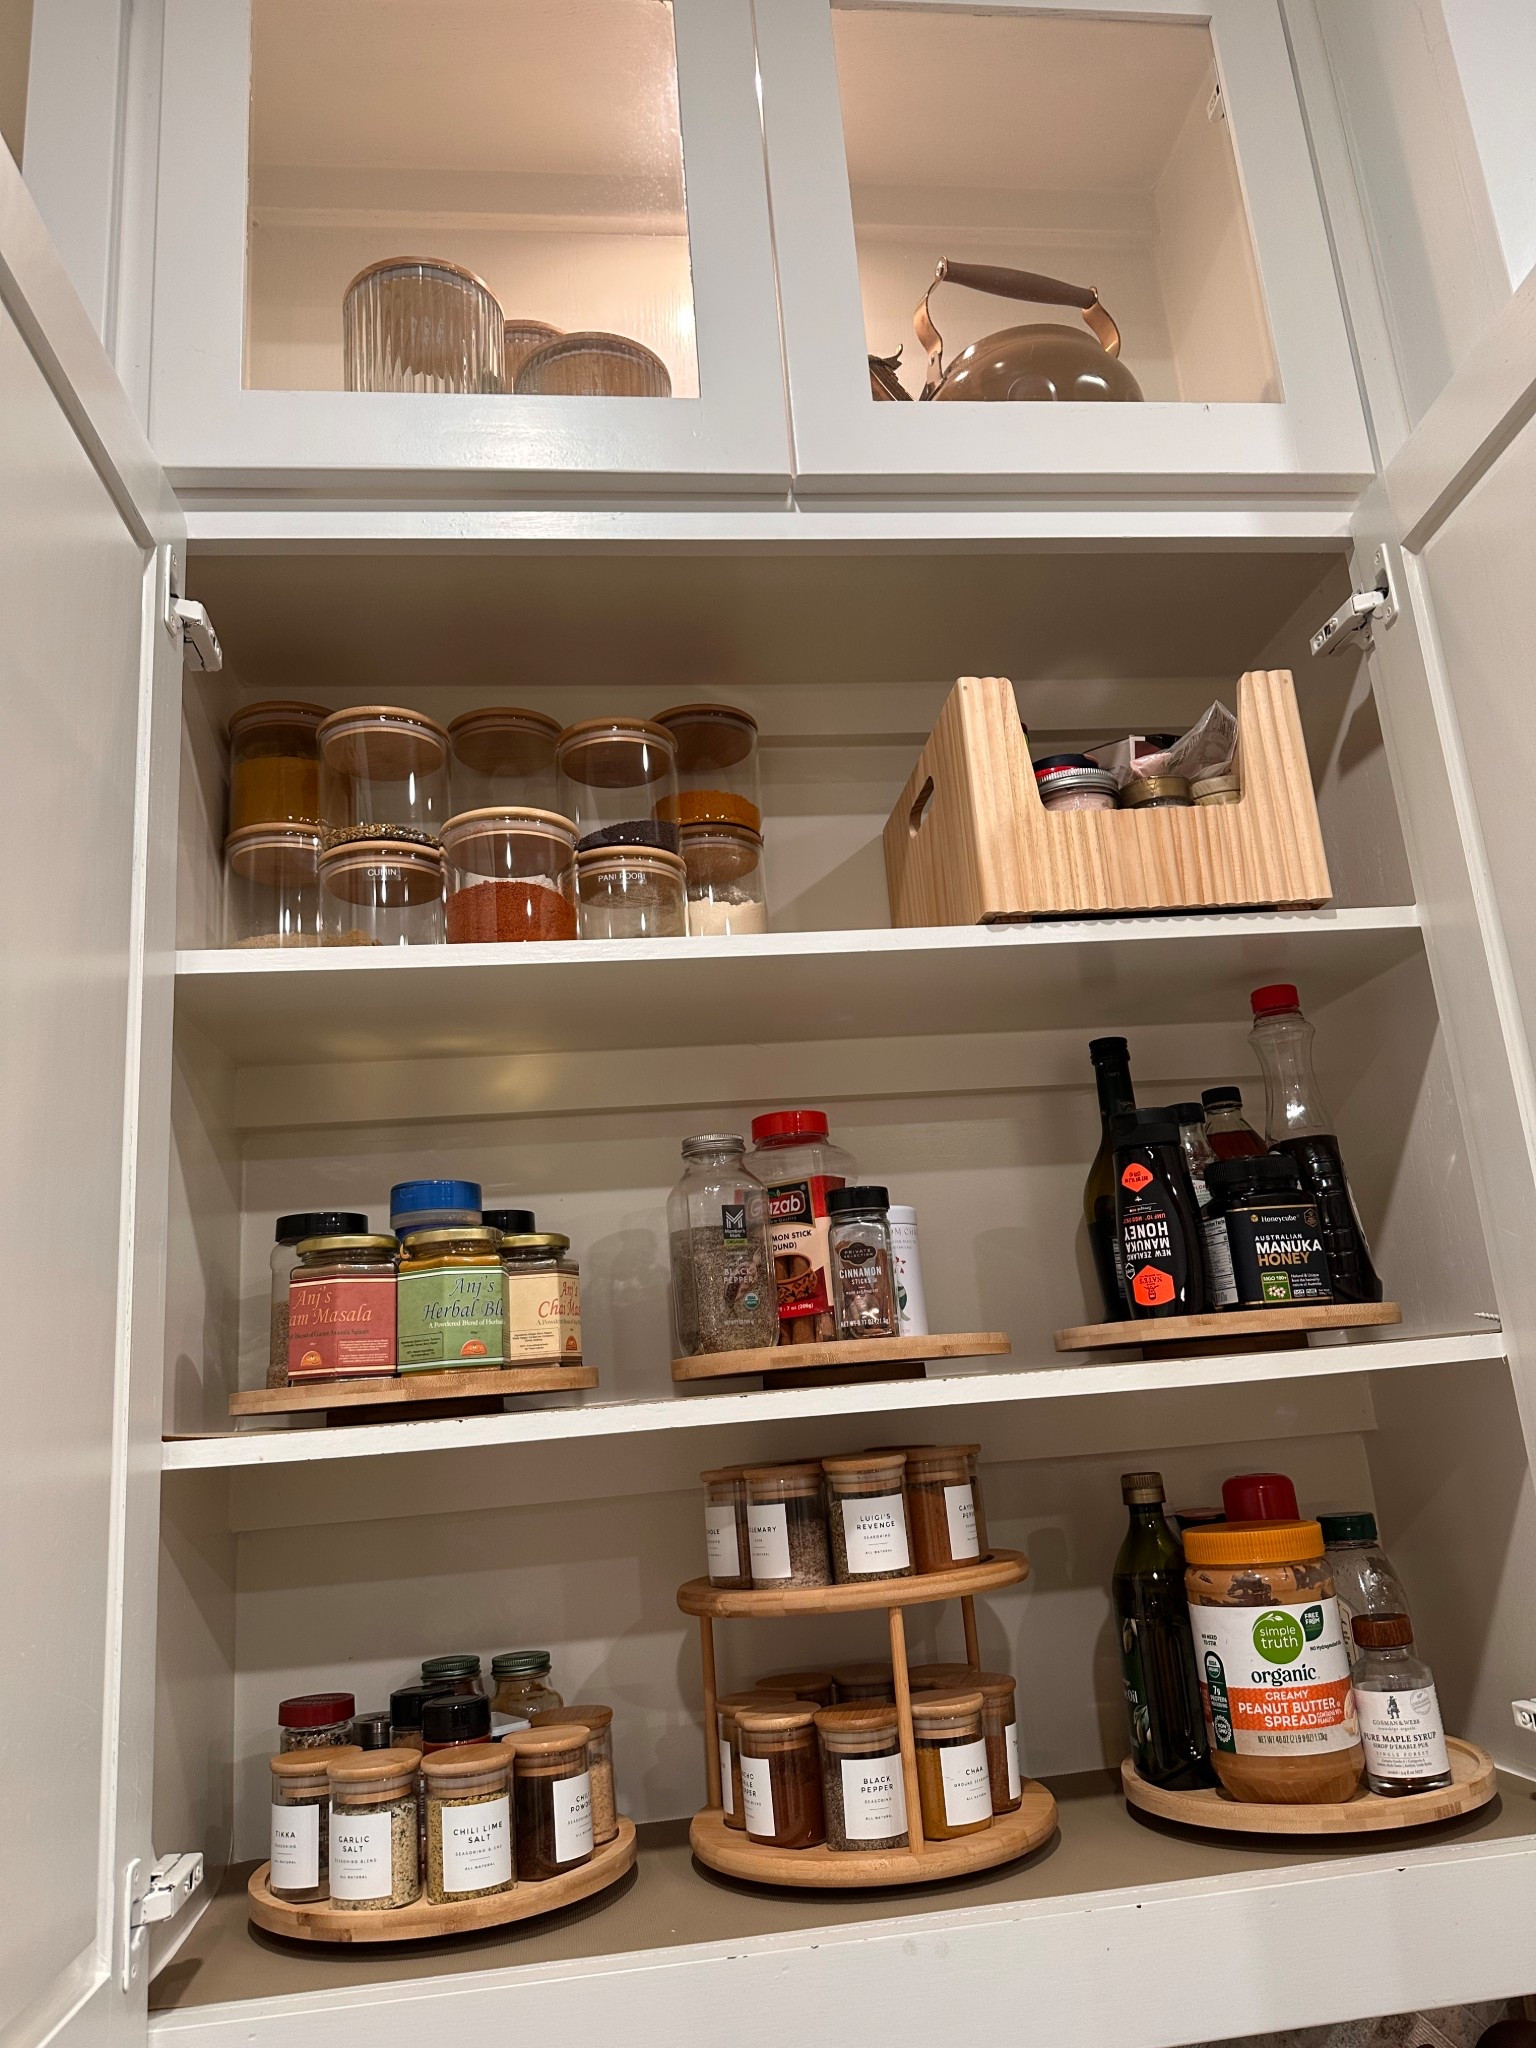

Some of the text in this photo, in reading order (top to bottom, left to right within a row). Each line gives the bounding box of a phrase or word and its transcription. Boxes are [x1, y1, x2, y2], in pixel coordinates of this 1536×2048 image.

[598, 873, 617, 882] PANI
[1261, 1214, 1297, 1223] Honeycube
[791, 1229, 812, 1239] STICK
[1124, 1221, 1169, 1241] HONEY
[1254, 1233, 1303, 1242] AUSTRALIAN
[1125, 1236, 1171, 1253] MANUKA
[1255, 1238, 1323, 1255] MANUKA
[1126, 1248, 1172, 1261] NEW ZEALAND
[1257, 1251, 1310, 1267] HONEY
[724, 1268, 753, 1276] BLACK
[839, 1265, 882, 1279] CINNAMON
[723, 1276, 754, 1284] PEPPER
[1139, 1276, 1163, 1285] NATE'S
[448, 1275, 495, 1299] Anj's
[560, 1281, 578, 1302] Anj's
[292, 1286, 332, 1311] Anj's
[422, 1299, 480, 1321] Herbal
[538, 1298, 566, 1318] Chai
[312, 1303, 372, 1325] Masala
[434, 1320, 461, 1328] Powdered
[461, 1319, 479, 1327] Blend
[860, 1513, 891, 1522] LUIGI'S
[856, 1520, 896, 1530] REVENGE
[1305, 1617, 1321, 1625] FROM
[1260, 1625, 1296, 1638] simple
[1261, 1635, 1298, 1649] truth
[1251, 1663, 1317, 1687] organic
[1212, 1685, 1221, 1696] 7g
[1265, 1689, 1309, 1701] CREAMY
[1238, 1697, 1336, 1714] PEANUT BUTTER
[1264, 1713, 1317, 1728] SPREAD
[1257, 1735, 1267, 1744] NET
[1363, 1731, 1437, 1743] PURE MAPLE SYRUP
[863, 1775, 891, 1785] BLACK
[860, 1783, 894, 1793] PEPPER
[453, 1820, 503, 1836] CHILI LIME
[275, 1830, 296, 1839] TIKKA
[338, 1835, 370, 1844] GARLIC
[468, 1833, 491, 1844] SALT
[342, 1845, 364, 1853] SALT
[455, 1848, 486, 1857] SEASONING
